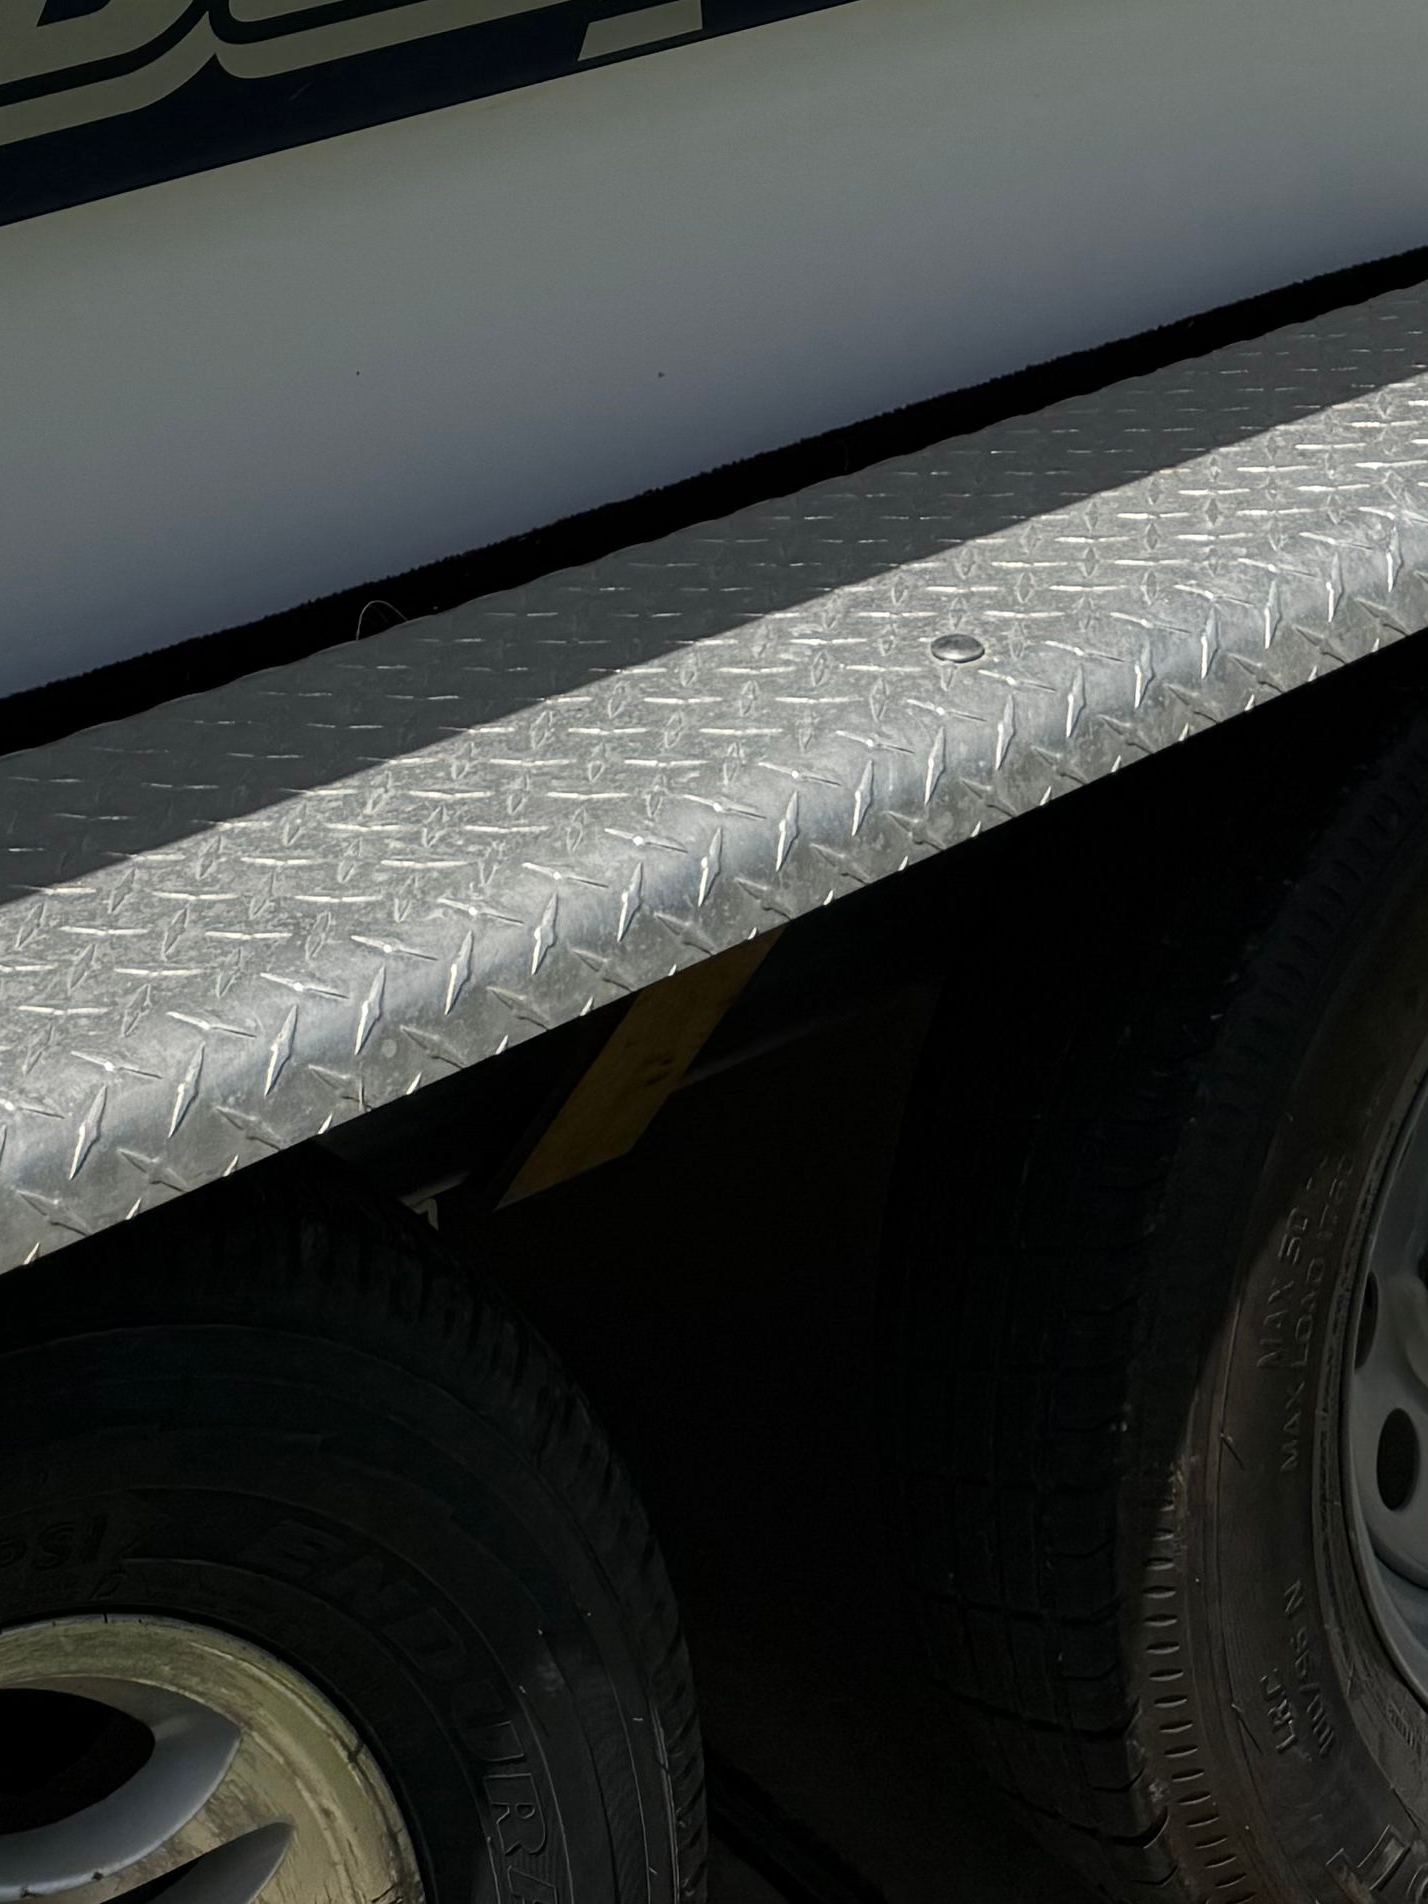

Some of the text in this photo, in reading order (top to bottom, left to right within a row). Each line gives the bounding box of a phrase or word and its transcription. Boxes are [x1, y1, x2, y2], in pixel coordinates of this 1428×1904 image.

[1256, 1278, 1295, 1368] MAX
[1290, 1255, 1325, 1369] LOAD
[1279, 1381, 1306, 1472] MAX
